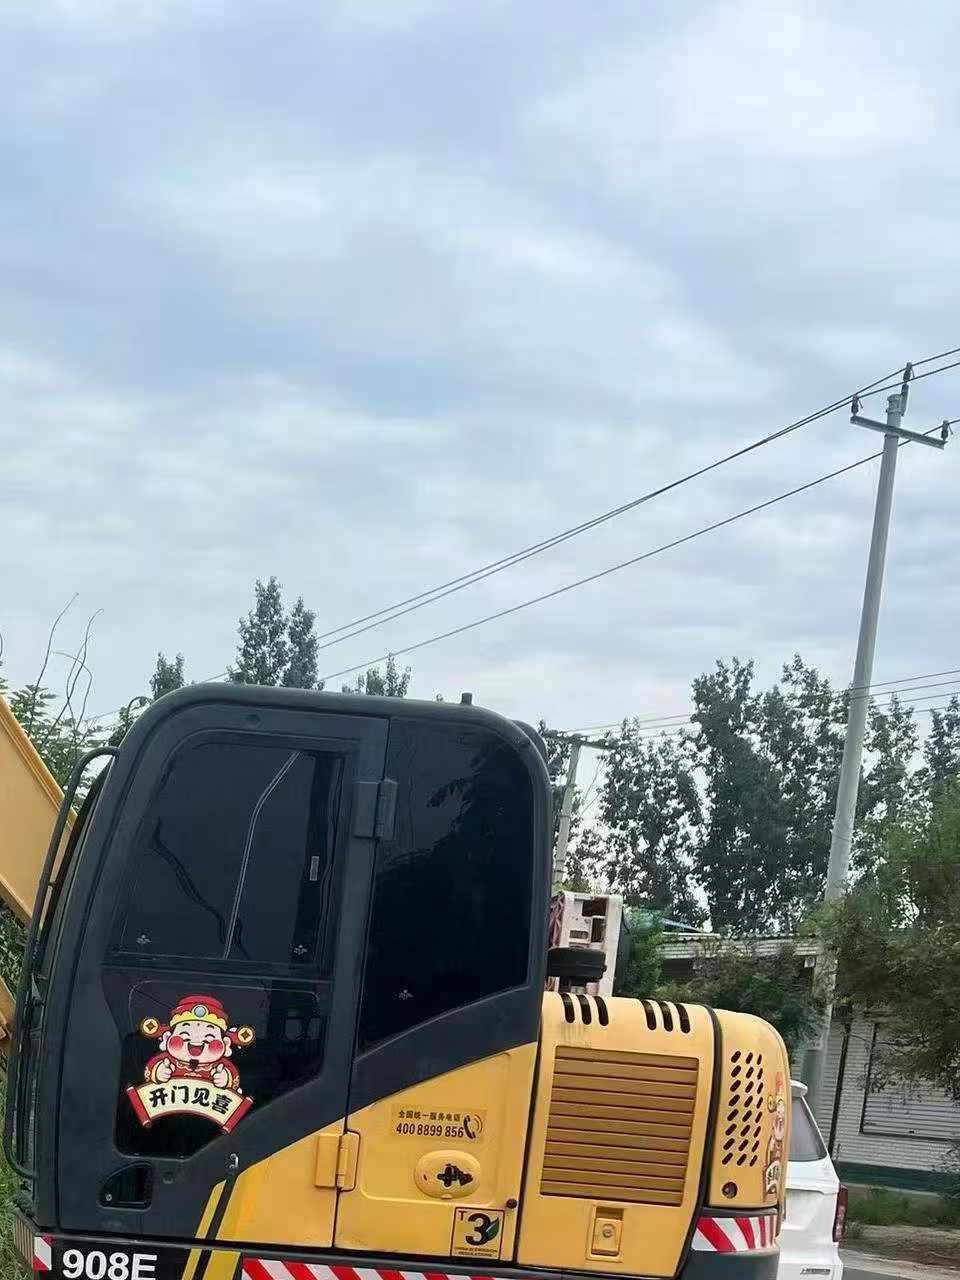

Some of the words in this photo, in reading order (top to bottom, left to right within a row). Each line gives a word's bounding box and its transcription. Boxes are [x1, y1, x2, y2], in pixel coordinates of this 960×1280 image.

[149, 1085, 233, 1115] 开门见喜
[396, 1123, 416, 1135] 400
[417, 1124, 443, 1136] 8899
[444, 1126, 464, 1138] 856
